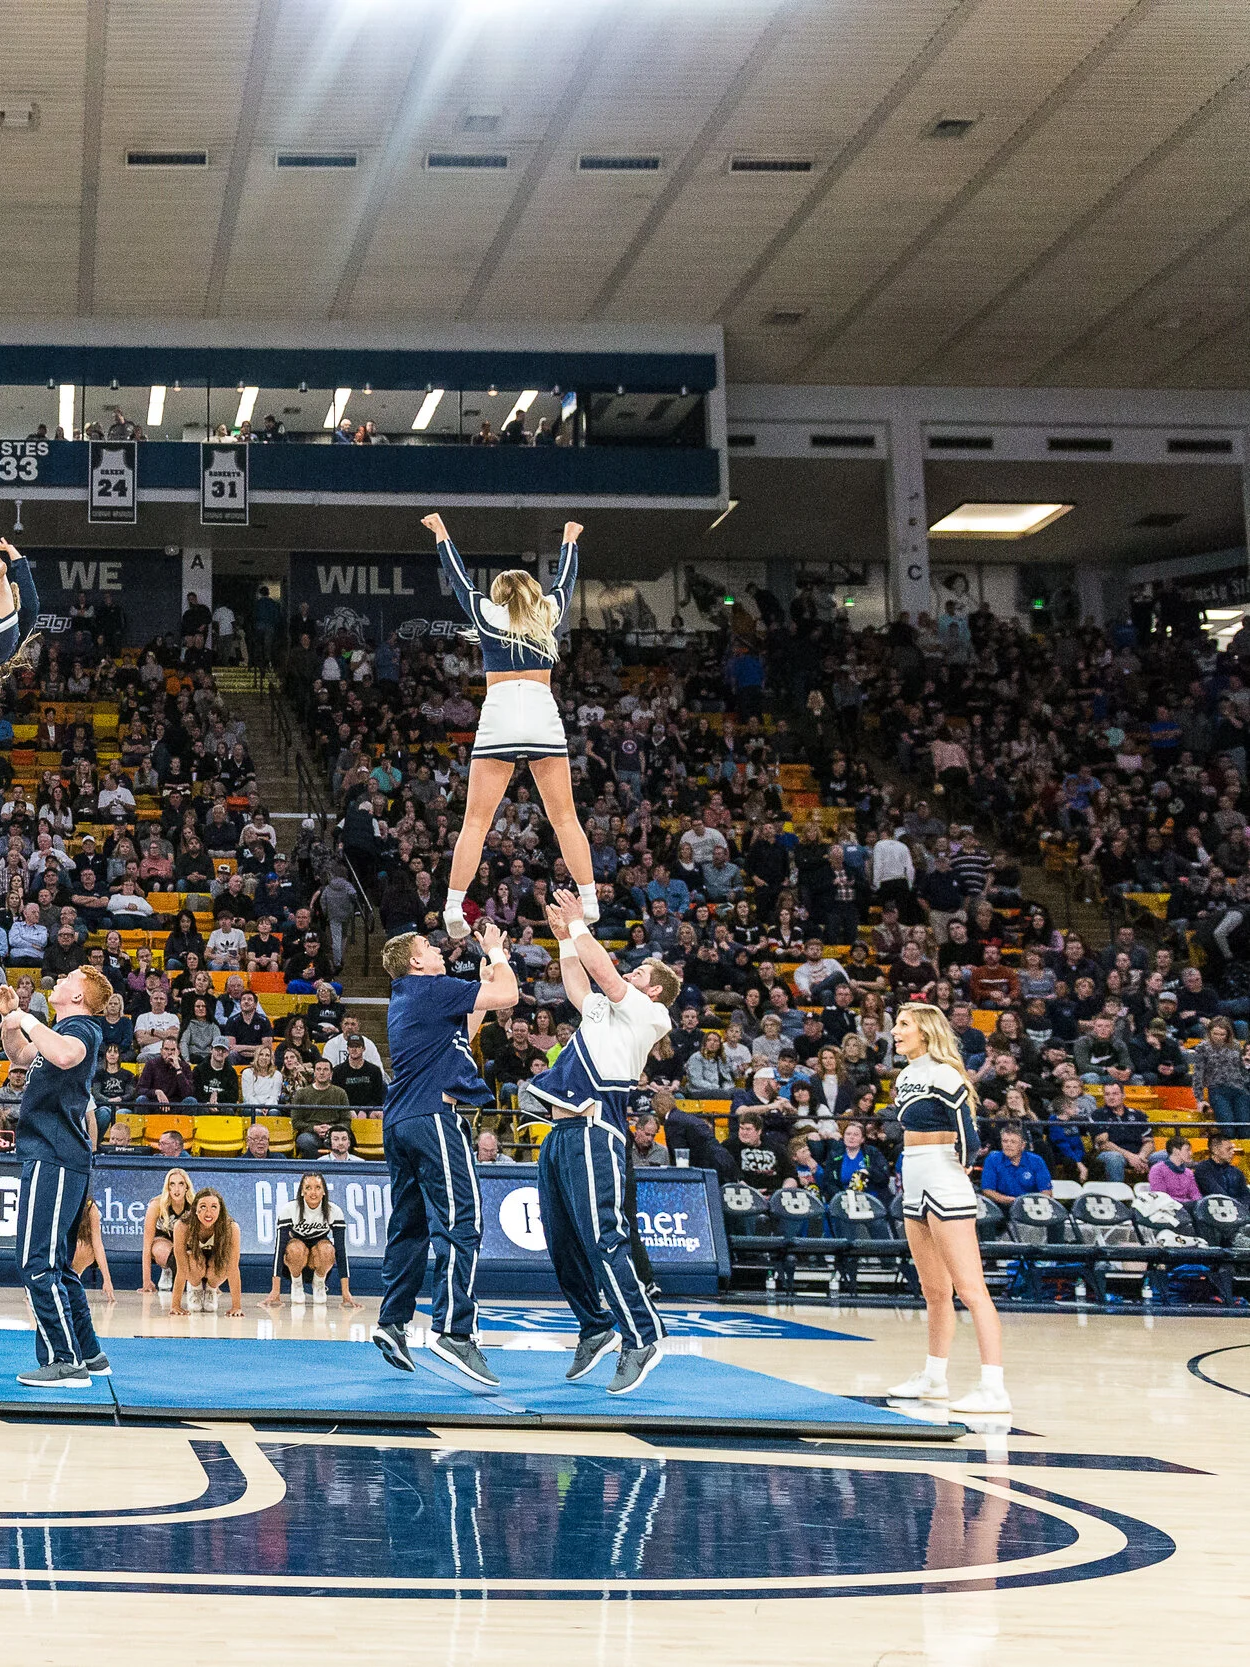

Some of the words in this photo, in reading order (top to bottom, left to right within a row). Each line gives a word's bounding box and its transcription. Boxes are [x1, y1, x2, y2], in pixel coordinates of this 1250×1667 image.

[98, 479, 128, 497] 24
[211, 481, 238, 498] 31
[190, 554, 205, 569] A
[58, 561, 123, 590] WE
[317, 565, 414, 595] WILL
[907, 565, 923, 580] C
